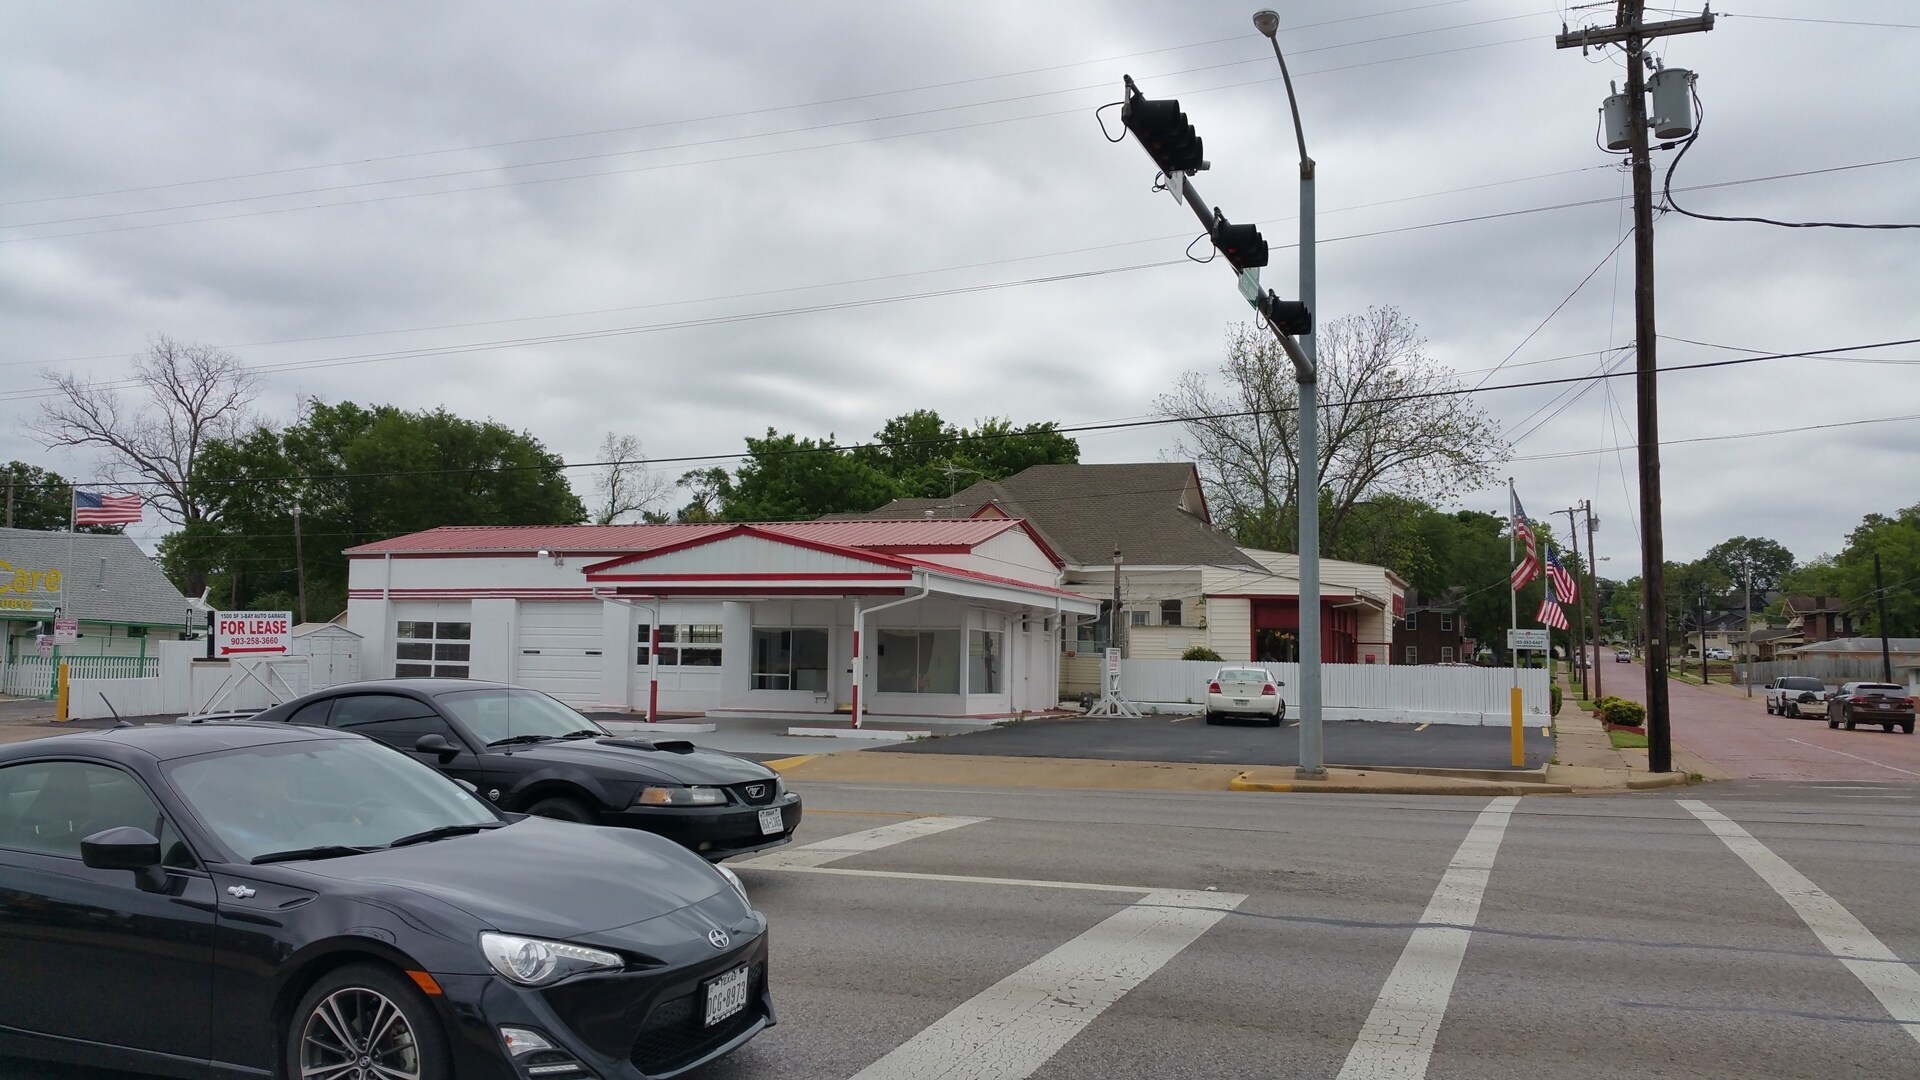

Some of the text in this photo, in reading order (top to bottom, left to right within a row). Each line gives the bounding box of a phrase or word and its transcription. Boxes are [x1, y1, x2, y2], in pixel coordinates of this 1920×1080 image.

[0, 560, 61, 592] Care
[220, 620, 287, 635] FOR LEASE
[230, 637, 279, 645] 903-258-3660
[720, 973, 737, 986] TEXAS
[710, 1006, 743, 1026] CLASSIC
